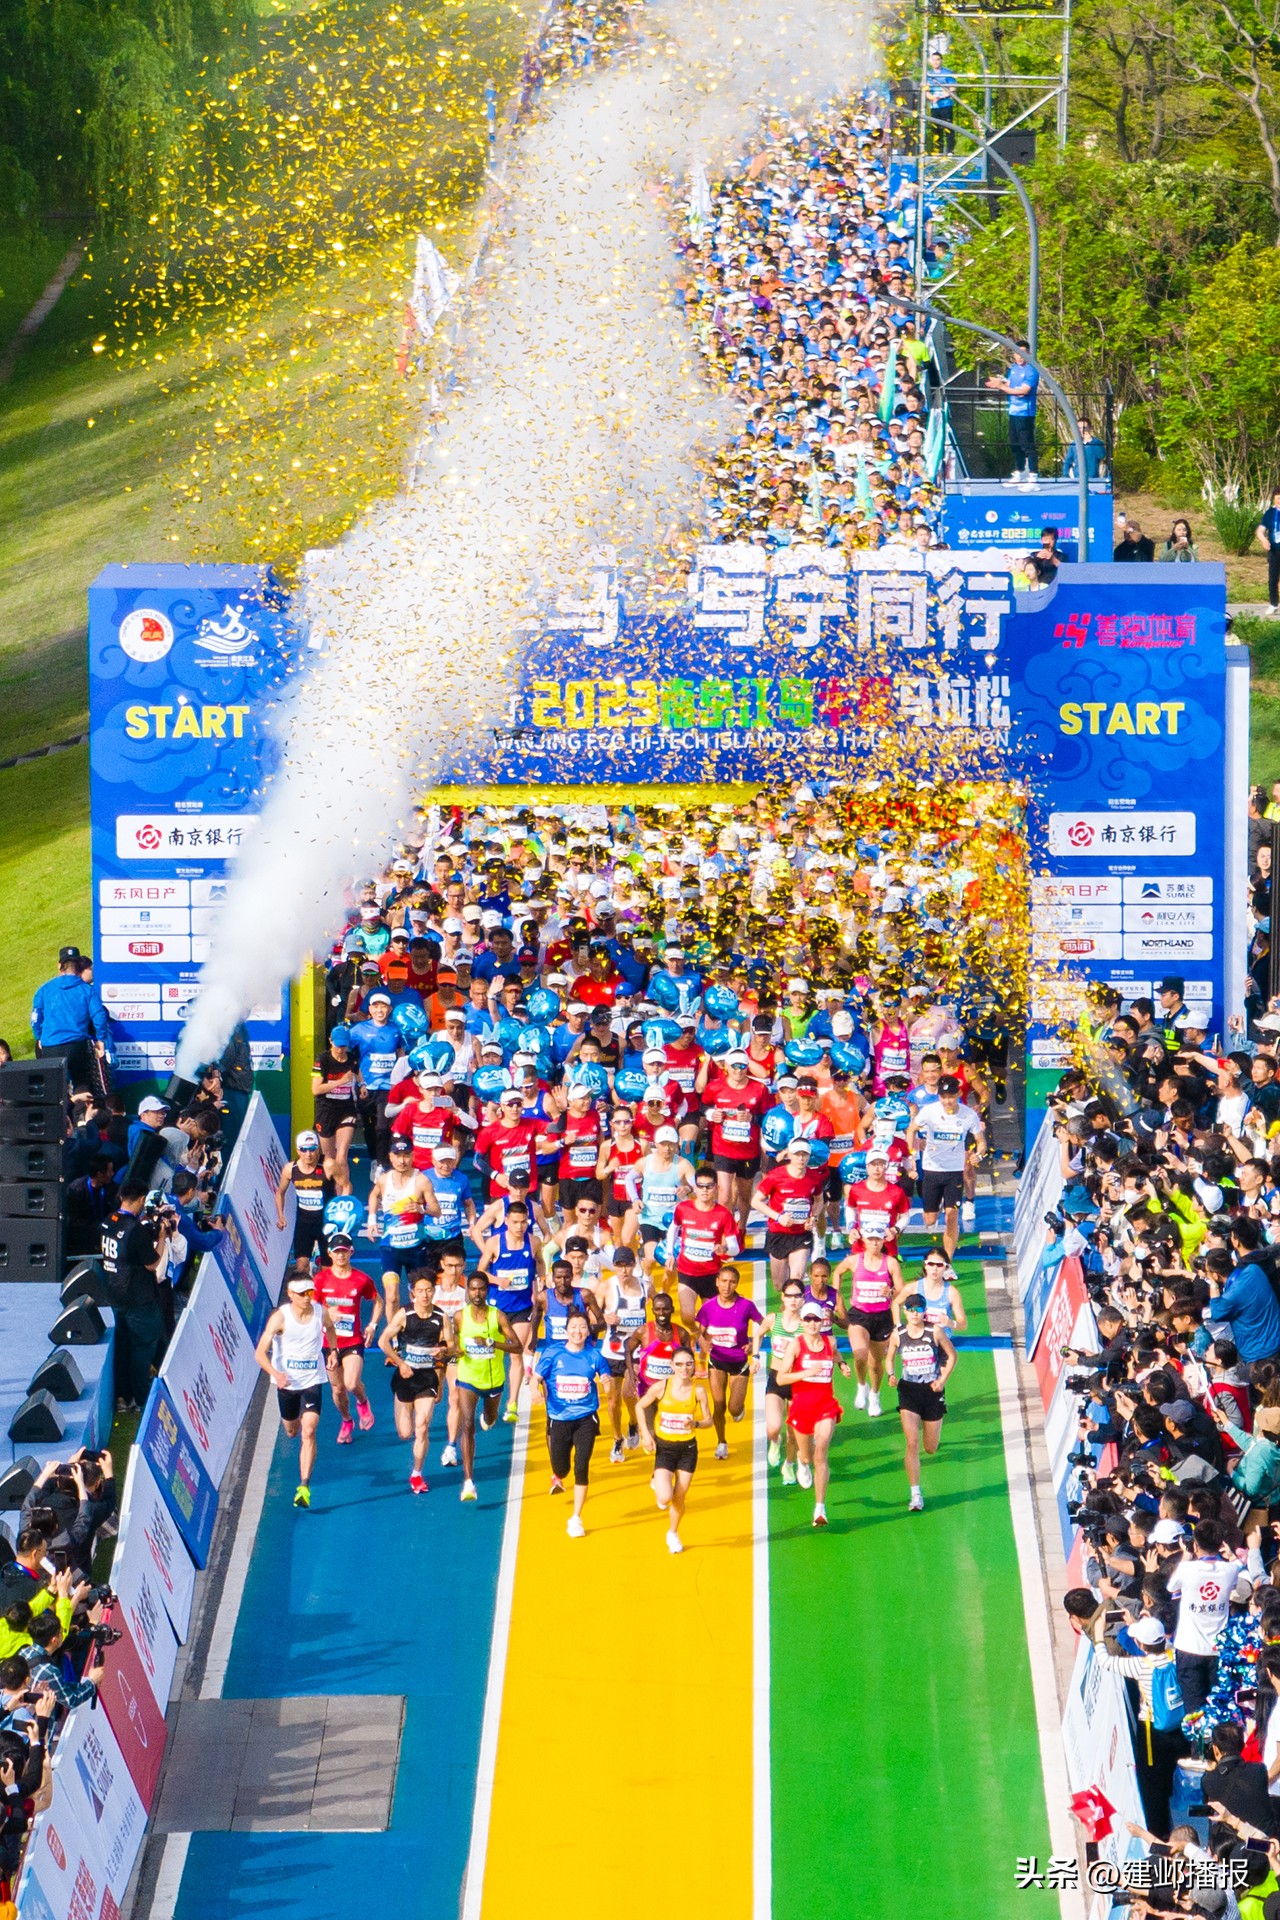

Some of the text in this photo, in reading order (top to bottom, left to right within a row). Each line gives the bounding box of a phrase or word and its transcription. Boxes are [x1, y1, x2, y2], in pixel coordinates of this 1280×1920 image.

[1095, 612, 1196, 646] 善跑体育
[125, 705, 250, 739] START
[1059, 702, 1185, 735] START
[844, 732, 892, 748] HAL
[168, 828, 243, 847] 南京银行
[1101, 824, 1177, 843] 南京银行
[113, 887, 176, 899] 东风日产
[1166, 884, 1196, 892] 苏美达
[1141, 939, 1195, 948] NORTHLAND
[327, 1200, 354, 1212] 2:00
[101, 1235, 118, 1259] HB
[288, 1361, 316, 1369] A00001
[1188, 1602, 1226, 1613] 南京银行
